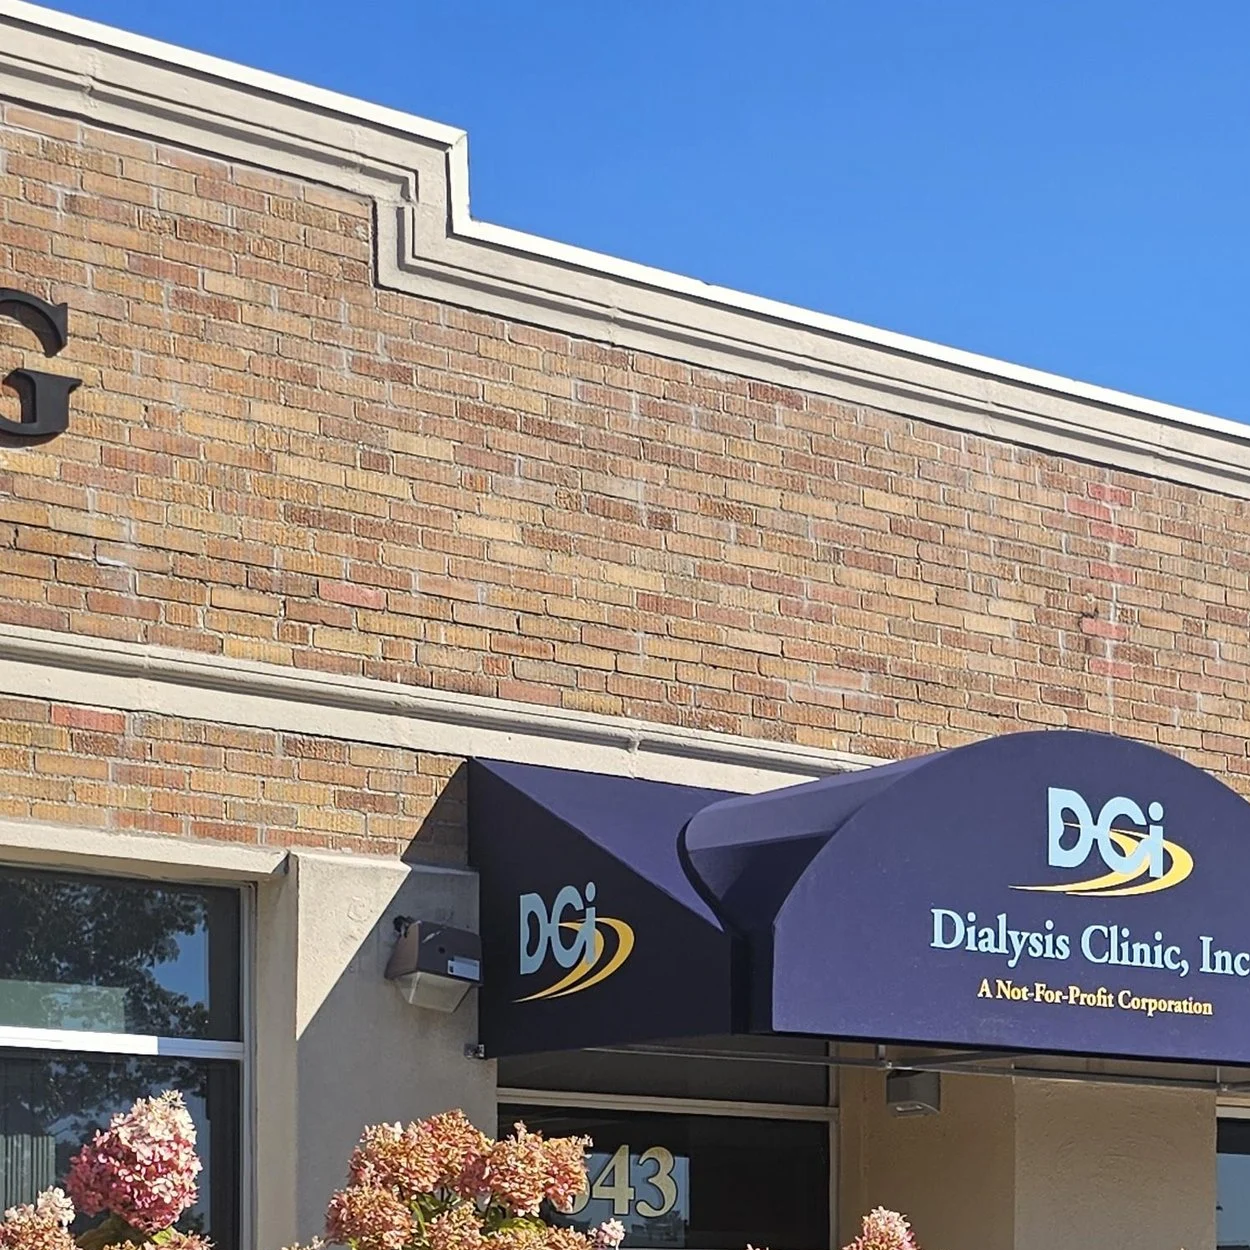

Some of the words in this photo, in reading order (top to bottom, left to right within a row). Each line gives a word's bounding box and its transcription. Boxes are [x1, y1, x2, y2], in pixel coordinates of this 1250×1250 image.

[930, 908, 1071, 968] Dialysis
[1081, 924, 1190, 977] Clinic,
[1199, 936, 1250, 977] Inc
[977, 978, 994, 999] A
[996, 980, 1115, 1009] Not-For-Profit
[1117, 990, 1213, 1017] Corporation
